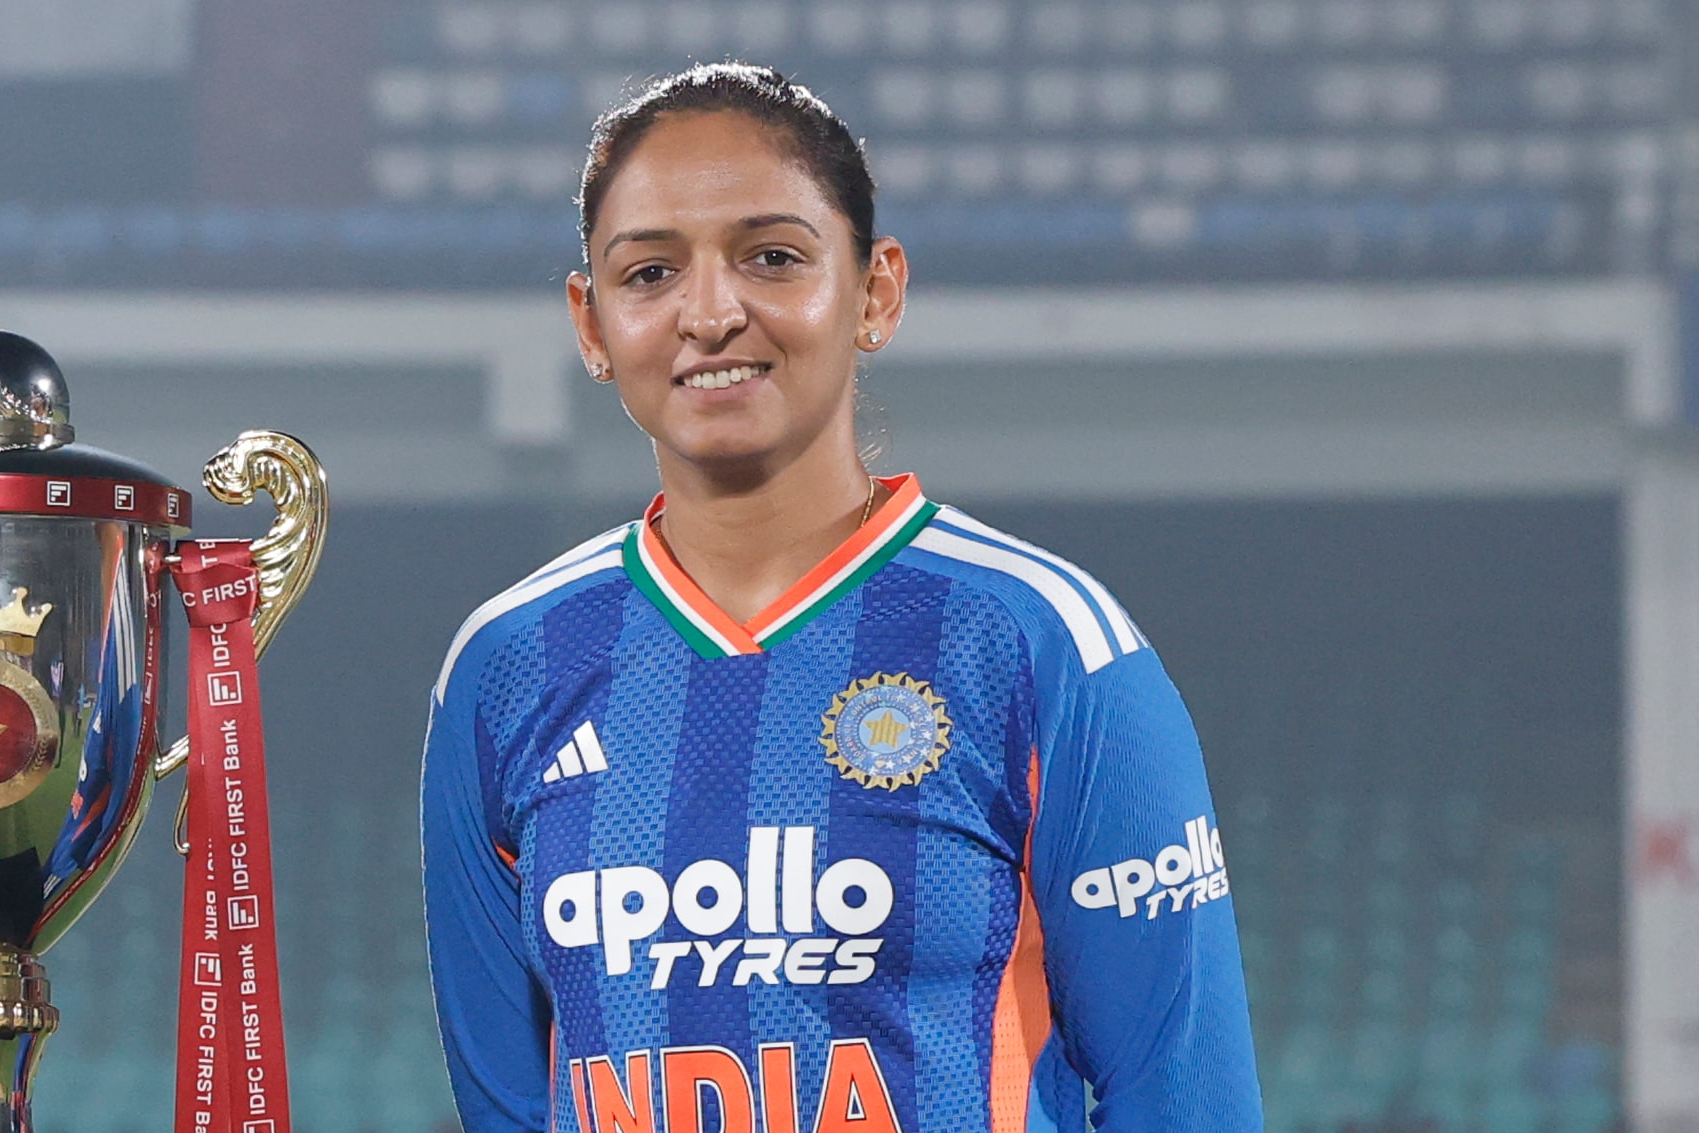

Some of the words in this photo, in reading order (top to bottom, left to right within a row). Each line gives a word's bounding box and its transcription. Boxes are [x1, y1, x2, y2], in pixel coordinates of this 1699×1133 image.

[202, 574, 257, 605] FIRST
[219, 718, 241, 771] Bank
[225, 776, 247, 836] FIRST
[230, 841, 250, 891] IDFC
[1071, 815, 1225, 919] apollo
[543, 825, 894, 977] apollo
[1145, 867, 1230, 921] TYRES
[237, 943, 258, 995] Bank
[647, 937, 884, 991] TYRES
[198, 990, 219, 1040] IDFC
[241, 1001, 263, 1061] FIRST
[196, 1045, 215, 1106] FIRST
[247, 1066, 266, 1115] IDFC
